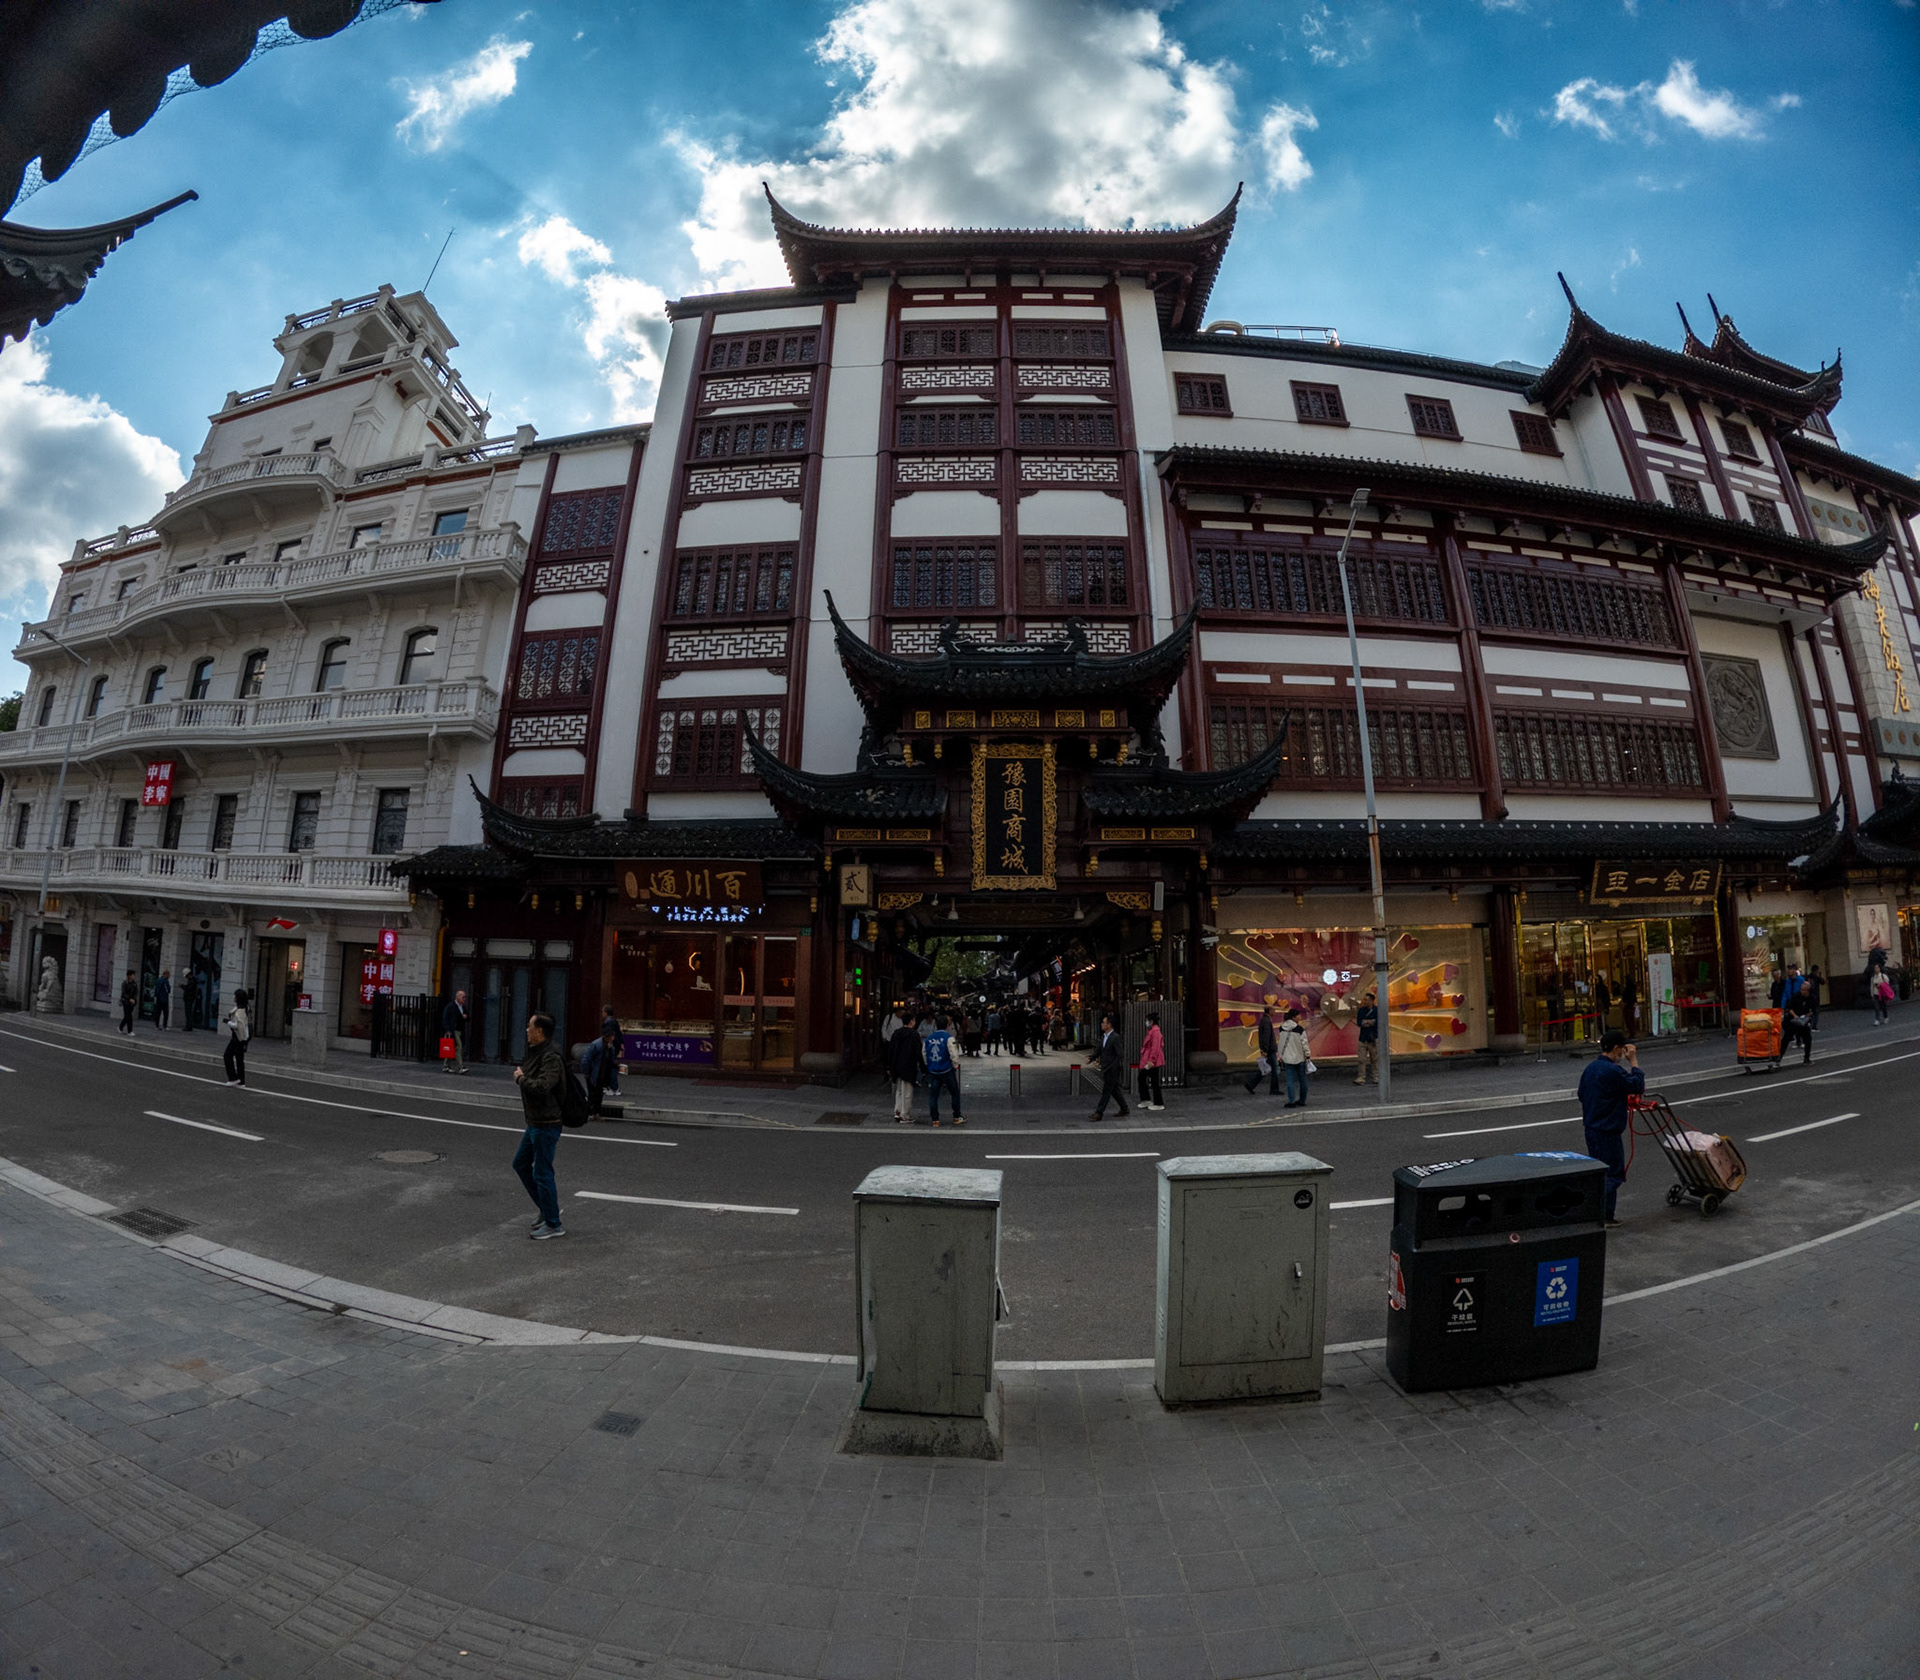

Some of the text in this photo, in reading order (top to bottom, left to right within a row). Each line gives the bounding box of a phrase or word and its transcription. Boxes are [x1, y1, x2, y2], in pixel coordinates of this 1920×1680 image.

[147, 763, 171, 781] 中國
[144, 785, 167, 803] 李寧
[1000, 761, 1029, 875] 豫園商城
[649, 868, 747, 900] 百川通
[1604, 869, 1711, 893] 亞一金店
[363, 962, 393, 981] 中國
